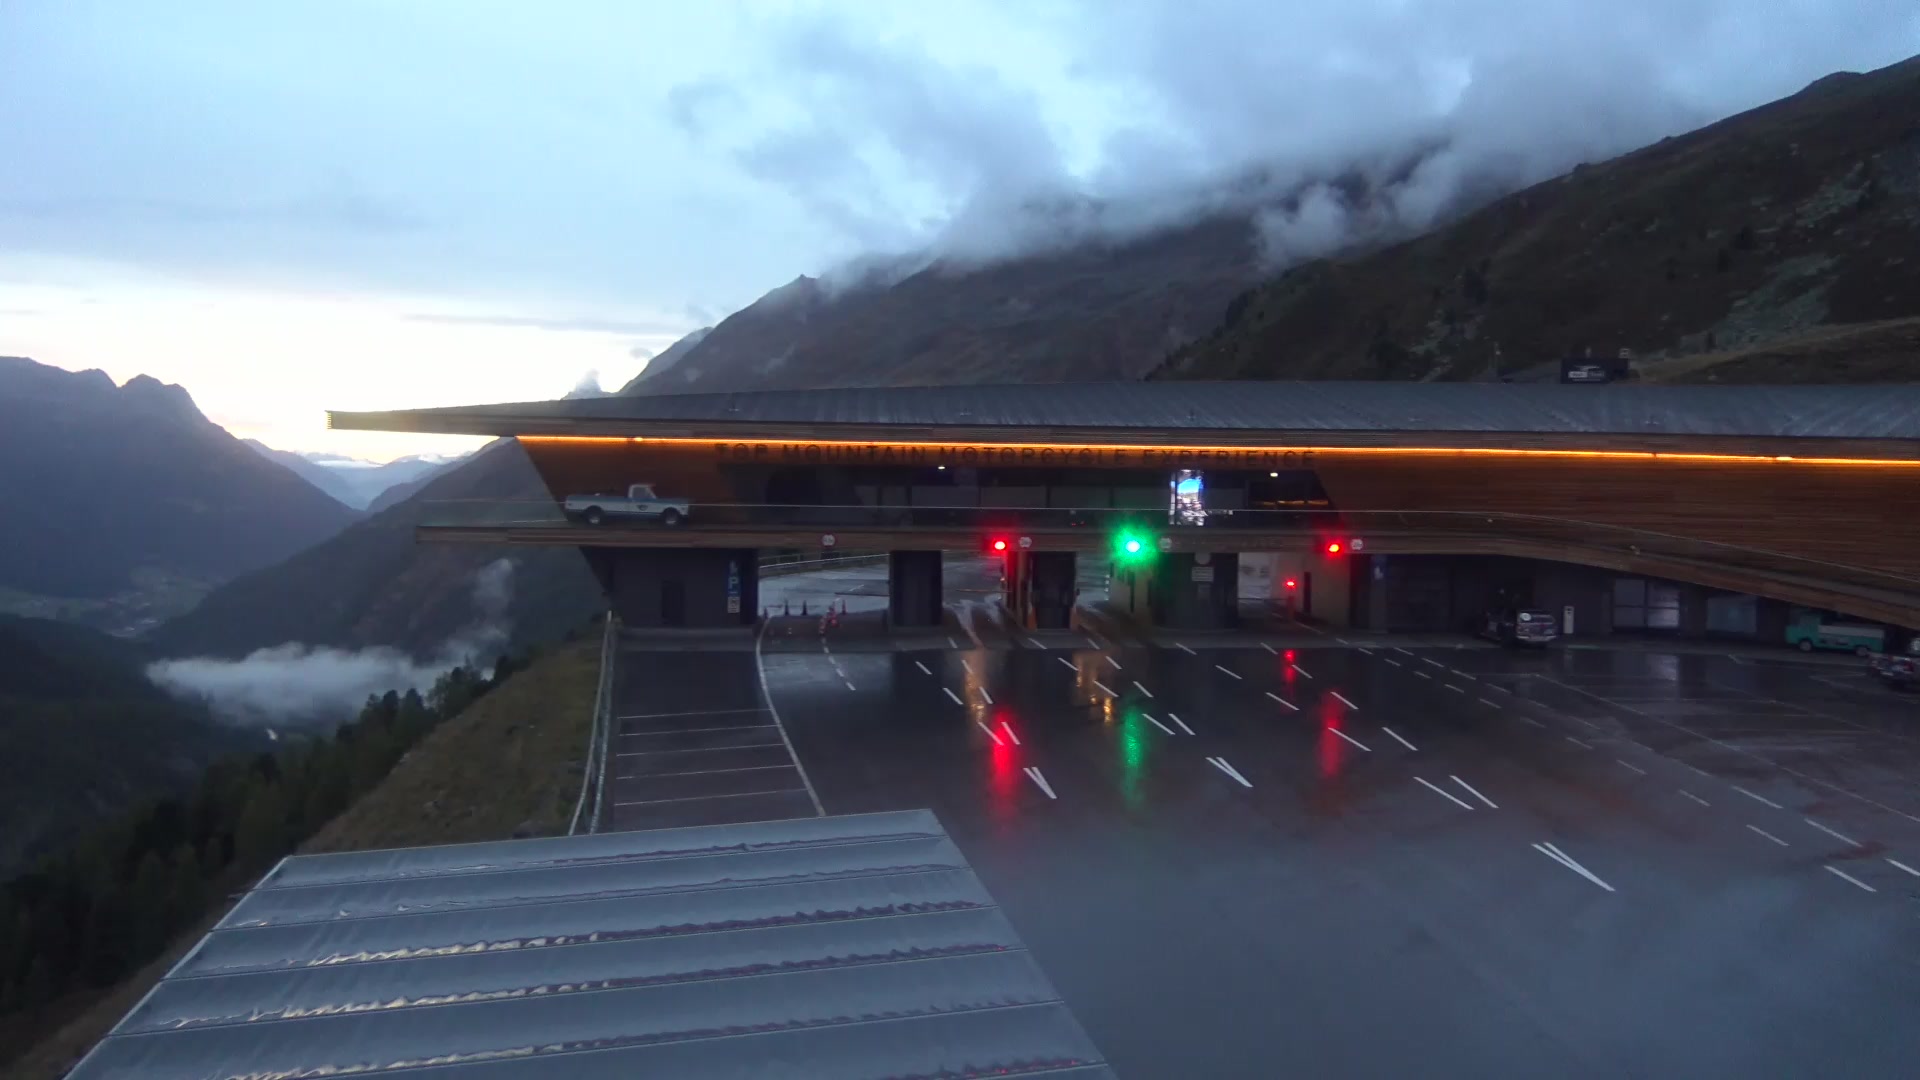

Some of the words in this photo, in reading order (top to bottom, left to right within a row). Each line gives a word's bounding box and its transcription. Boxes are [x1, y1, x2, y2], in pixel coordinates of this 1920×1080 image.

[716, 443, 768, 460] TOP
[783, 444, 925, 463] MOUNTAIN
[941, 447, 1126, 465] MOTORCYCLE
[1143, 450, 1314, 468] EXPERIENCE
[728, 576, 739, 589] P
